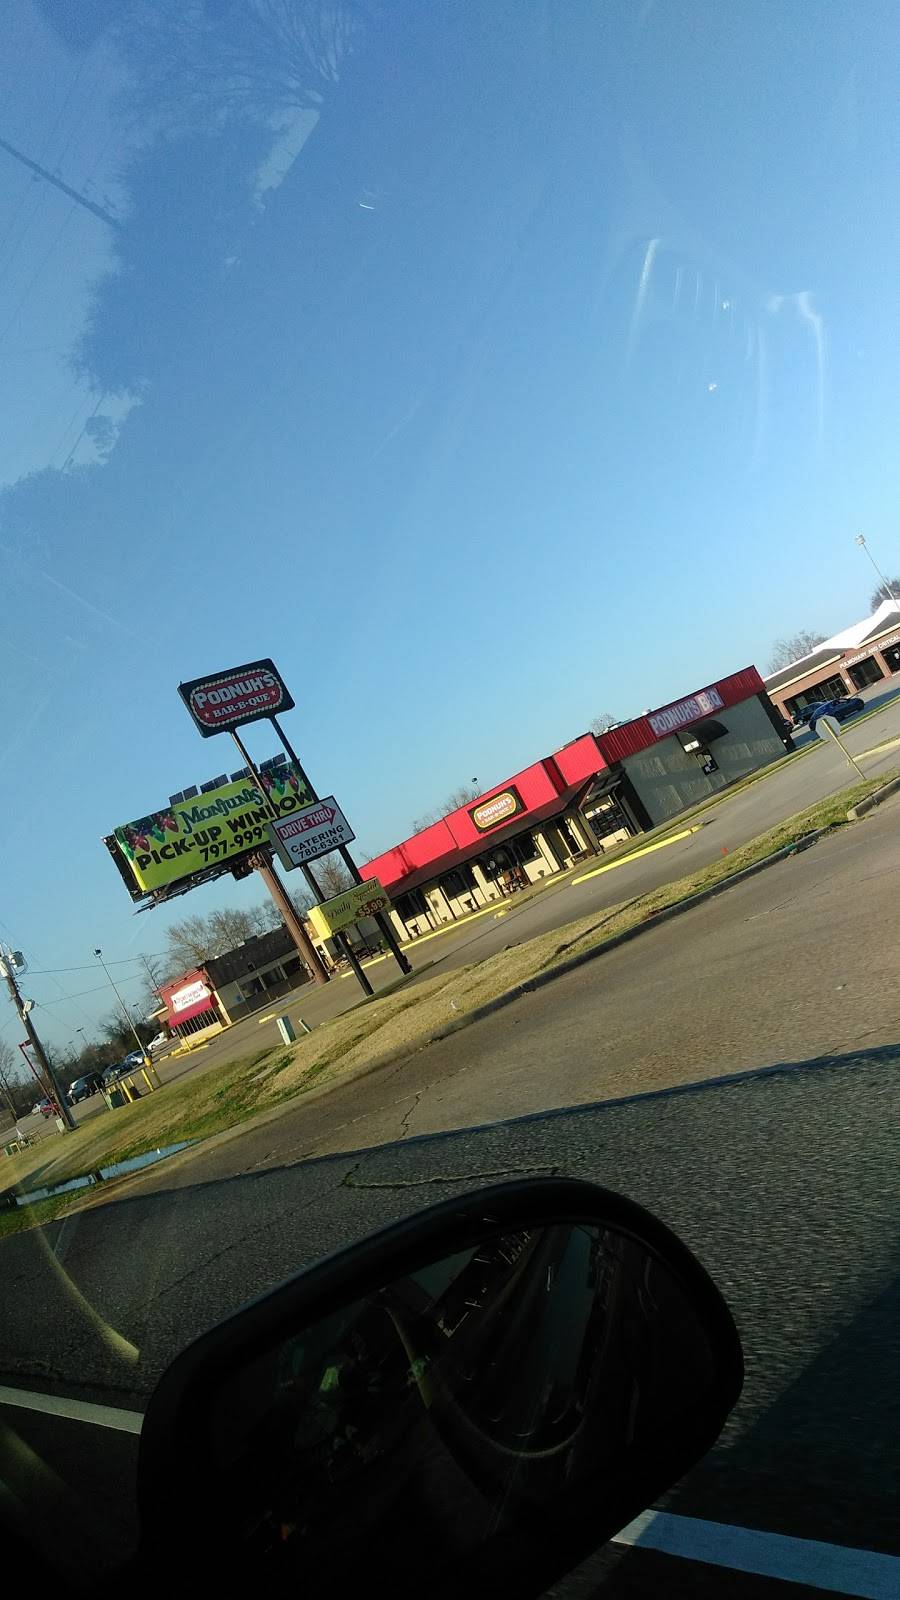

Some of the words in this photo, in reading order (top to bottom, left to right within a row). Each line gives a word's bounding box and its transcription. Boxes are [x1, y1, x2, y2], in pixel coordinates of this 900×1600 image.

[193, 673, 276, 709] PODNUH'S
[649, 699, 700, 735] PODNUH'S
[279, 817, 309, 839] DRIVE
[307, 807, 333, 826] THRU
[477, 796, 513, 820] PODNUH'S
[135, 825, 222, 871] PICK-UP
[290, 824, 345, 853] CATERING
[298, 834, 344, 859] 780-6361
